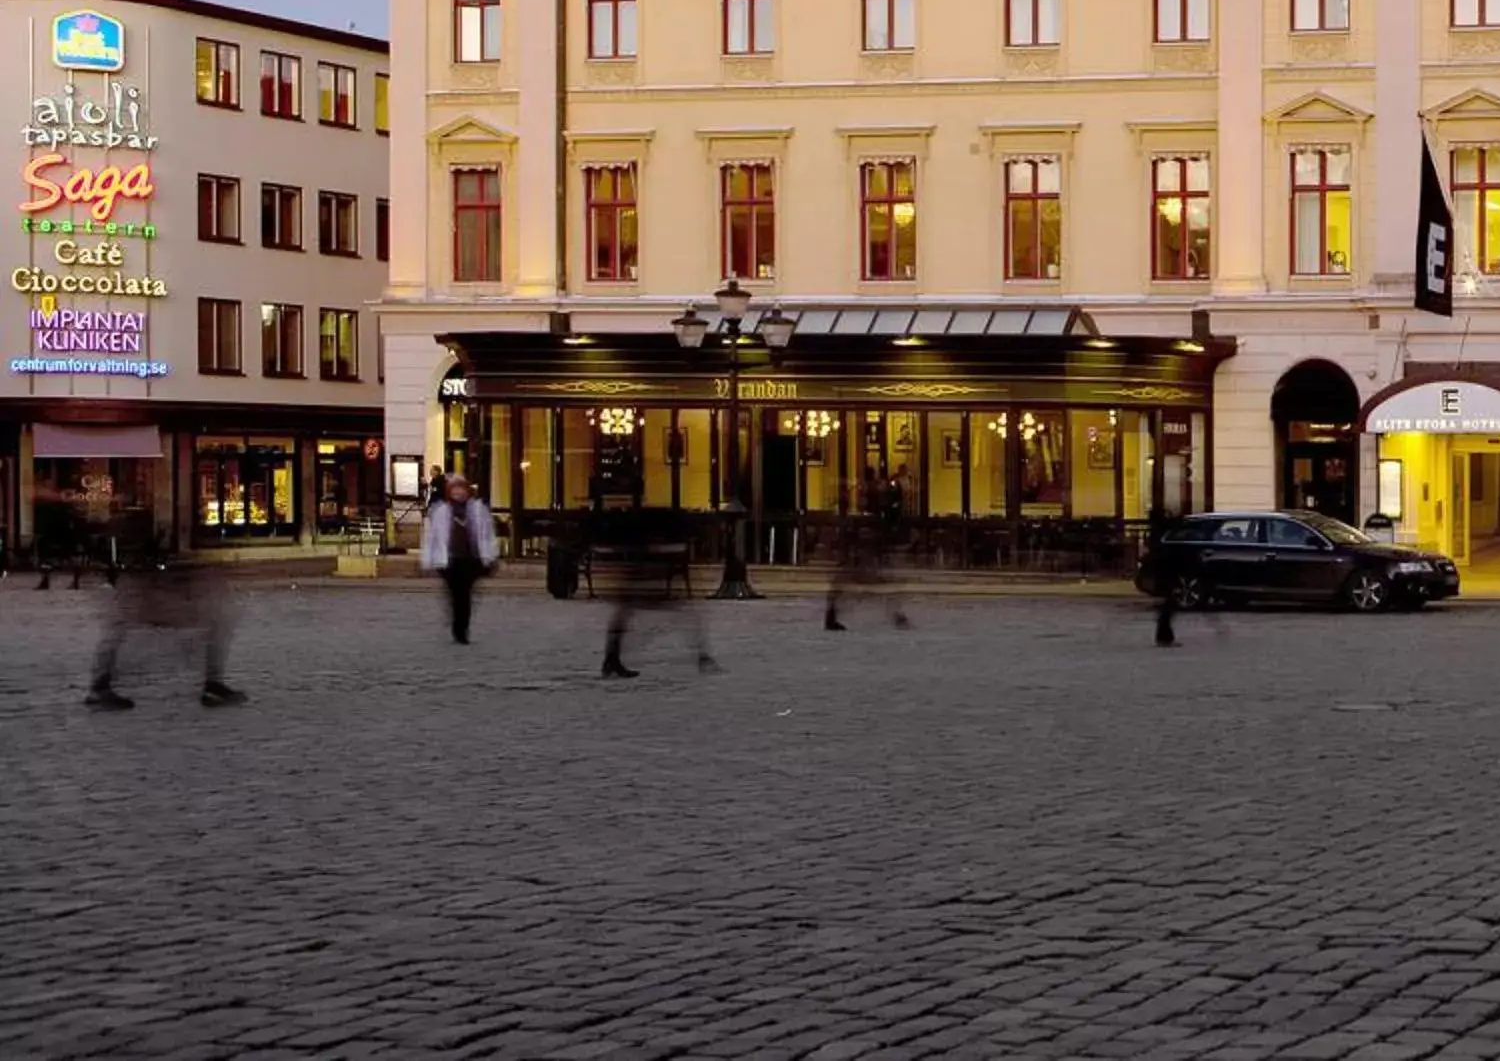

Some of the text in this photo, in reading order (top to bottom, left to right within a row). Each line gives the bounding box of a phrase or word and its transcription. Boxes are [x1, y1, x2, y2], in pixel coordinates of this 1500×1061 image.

[33, 82, 141, 131] aioli
[20, 122, 159, 152] tapasbar
[18, 153, 154, 222] Saga
[23, 218, 157, 239] teatern
[54, 240, 125, 265] Café
[11, 267, 168, 296] Cioccolata
[30, 310, 147, 331] IMPLANTAT
[38, 330, 141, 351] KLINIKEN
[713, 378, 798, 399] Vrandan
[1440, 388, 1461, 415] E
